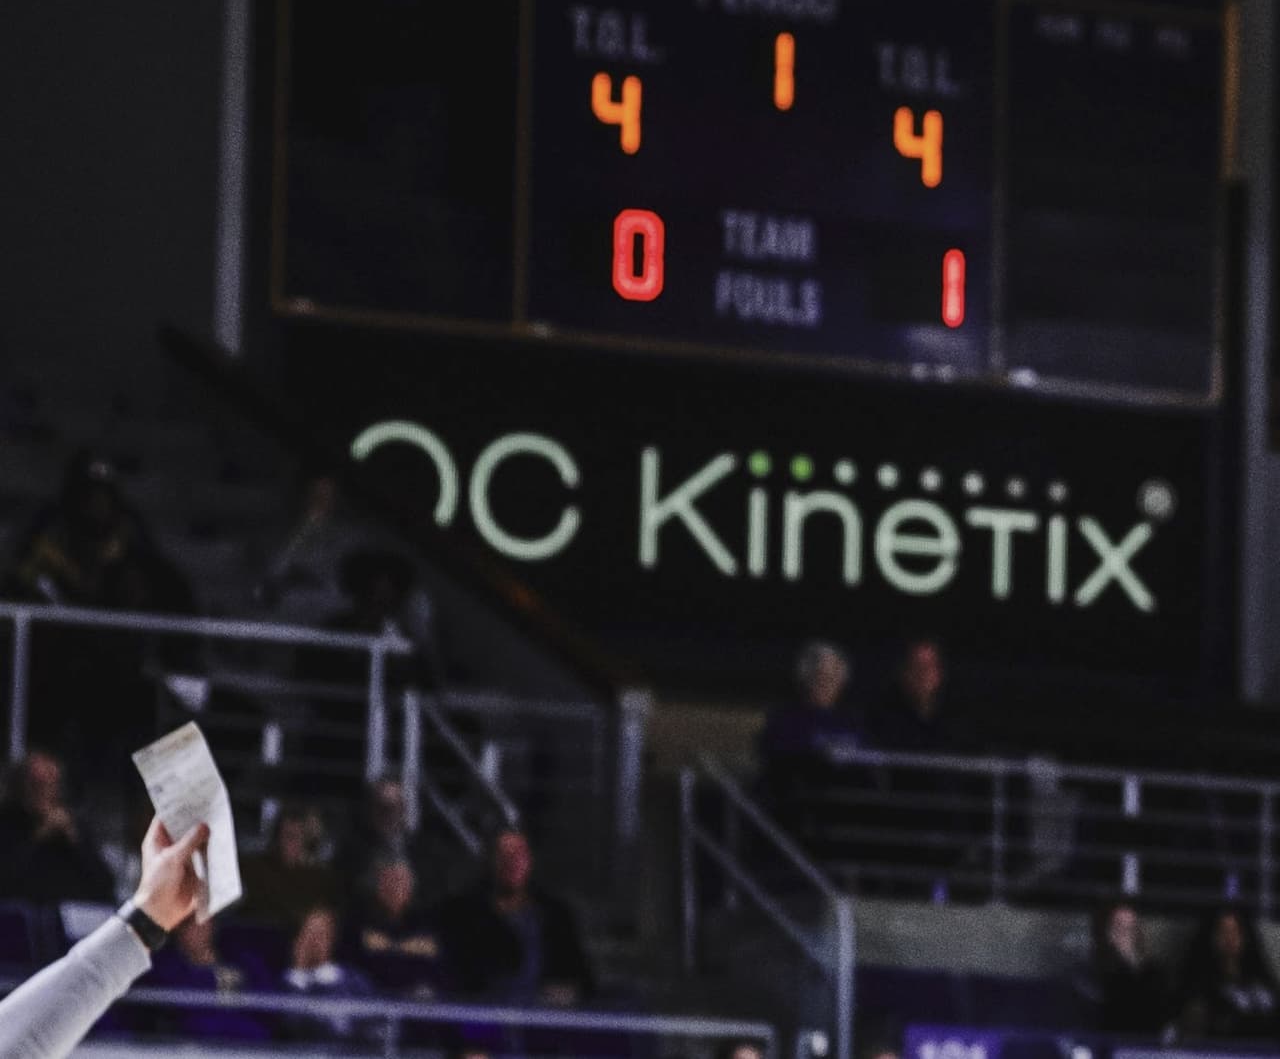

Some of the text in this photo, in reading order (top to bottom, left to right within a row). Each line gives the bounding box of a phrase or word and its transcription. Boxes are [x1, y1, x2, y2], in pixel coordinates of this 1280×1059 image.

[774, 31, 796, 111] 1
[590, 71, 644, 156] 4
[893, 106, 944, 190] 4
[611, 208, 666, 303] 0
[719, 208, 820, 265] TEAM
[716, 270, 824, 328] FOULS
[940, 247, 967, 329] 1
